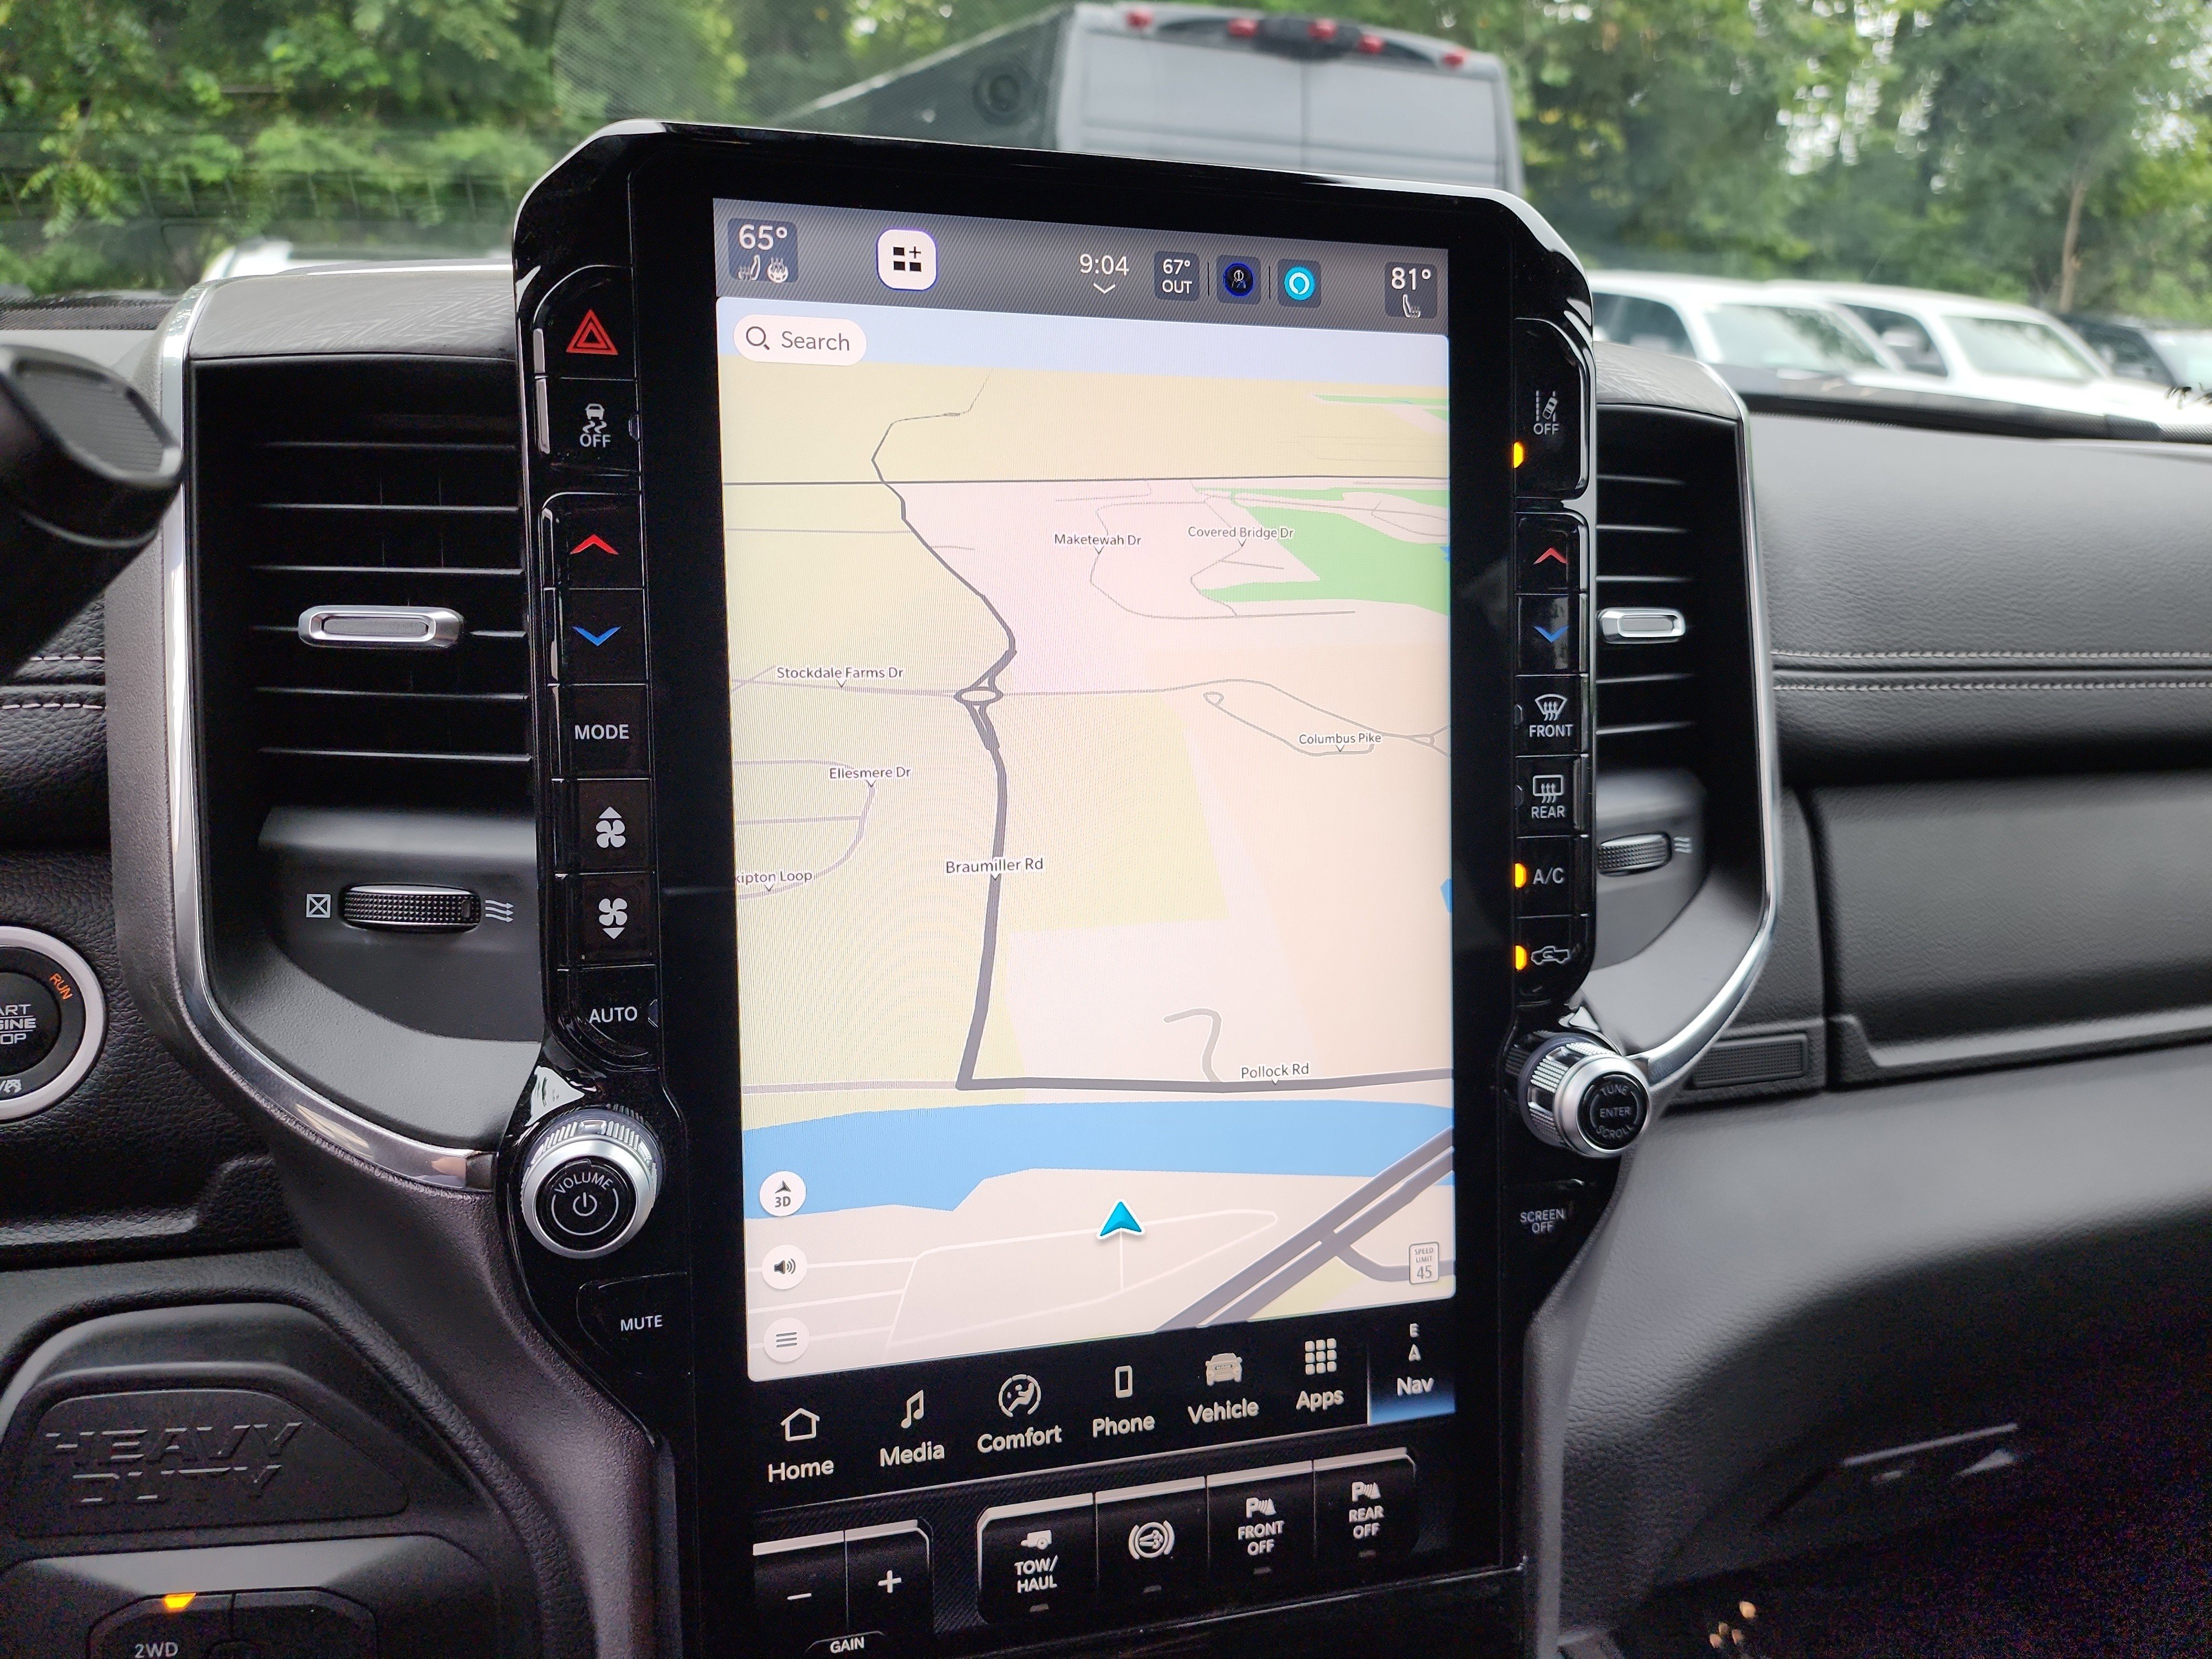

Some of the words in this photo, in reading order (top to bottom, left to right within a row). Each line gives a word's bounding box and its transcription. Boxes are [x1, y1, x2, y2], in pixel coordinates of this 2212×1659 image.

[738, 225, 787, 251] 65°
[1079, 254, 1130, 276] 9:04
[1162, 259, 1191, 275] 67°
[1162, 279, 1192, 294] OUT
[1391, 267, 1431, 291] 81°
[781, 331, 851, 351] Search
[1533, 423, 1559, 435] OFF
[580, 434, 611, 447] OFF
[1055, 533, 1123, 546] Maketewah
[1127, 534, 1141, 546] Dr
[1188, 525, 1237, 538] Covered
[1240, 525, 1277, 541] Bridge
[1280, 527, 1294, 539] Dr
[777, 667, 842, 679] Stockdale
[846, 667, 885, 679] Farms
[889, 667, 904, 678] Dr
[575, 724, 629, 739] MODE
[1299, 732, 1355, 745] Columbus
[1359, 732, 1381, 744] Pike
[1530, 724, 1573, 737] FRONT
[830, 767, 893, 779] Ellesmere
[896, 766, 911, 778] Dr
[1531, 806, 1564, 818] REAR
[946, 859, 1021, 874] Braumiller
[1025, 858, 1043, 871] Rd
[780, 871, 812, 883] Loop
[1533, 867, 1564, 884] A/C
[50, 973, 73, 1000] RUN
[589, 1006, 638, 1024] AUTO
[1241, 1065, 1288, 1078] Pollock
[1292, 1063, 1309, 1075] Rd
[1600, 1084, 1628, 1097] TUNE
[1600, 1106, 1631, 1118] ENTER
[1596, 1125, 1634, 1139] SCROLL
[555, 1172, 613, 1194] VOLUME
[775, 1196, 791, 1208] 3D
[1520, 1208, 1565, 1224] SCREEN
[1532, 1223, 1553, 1234] OFF
[1417, 1265, 1432, 1279] 45
[620, 1314, 663, 1332] MUTE
[1397, 1378, 1433, 1397] Nav
[1296, 1389, 1344, 1412] Apps
[1188, 1398, 1259, 1423] Vehicle
[1092, 1415, 1155, 1438] Phone
[977, 1425, 1062, 1453] Comfort
[880, 1441, 945, 1467] Media
[768, 1459, 834, 1483] Home
[1349, 1505, 1384, 1522] REAR
[1238, 1520, 1284, 1540] FRONT
[1353, 1522, 1380, 1539] OFF
[1248, 1540, 1275, 1556] OFF
[1015, 1555, 1058, 1575] TOW/
[1018, 1575, 1057, 1594] HAUL
[134, 1641, 178, 1658] 2WD
[830, 1636, 865, 1653] GAIN
